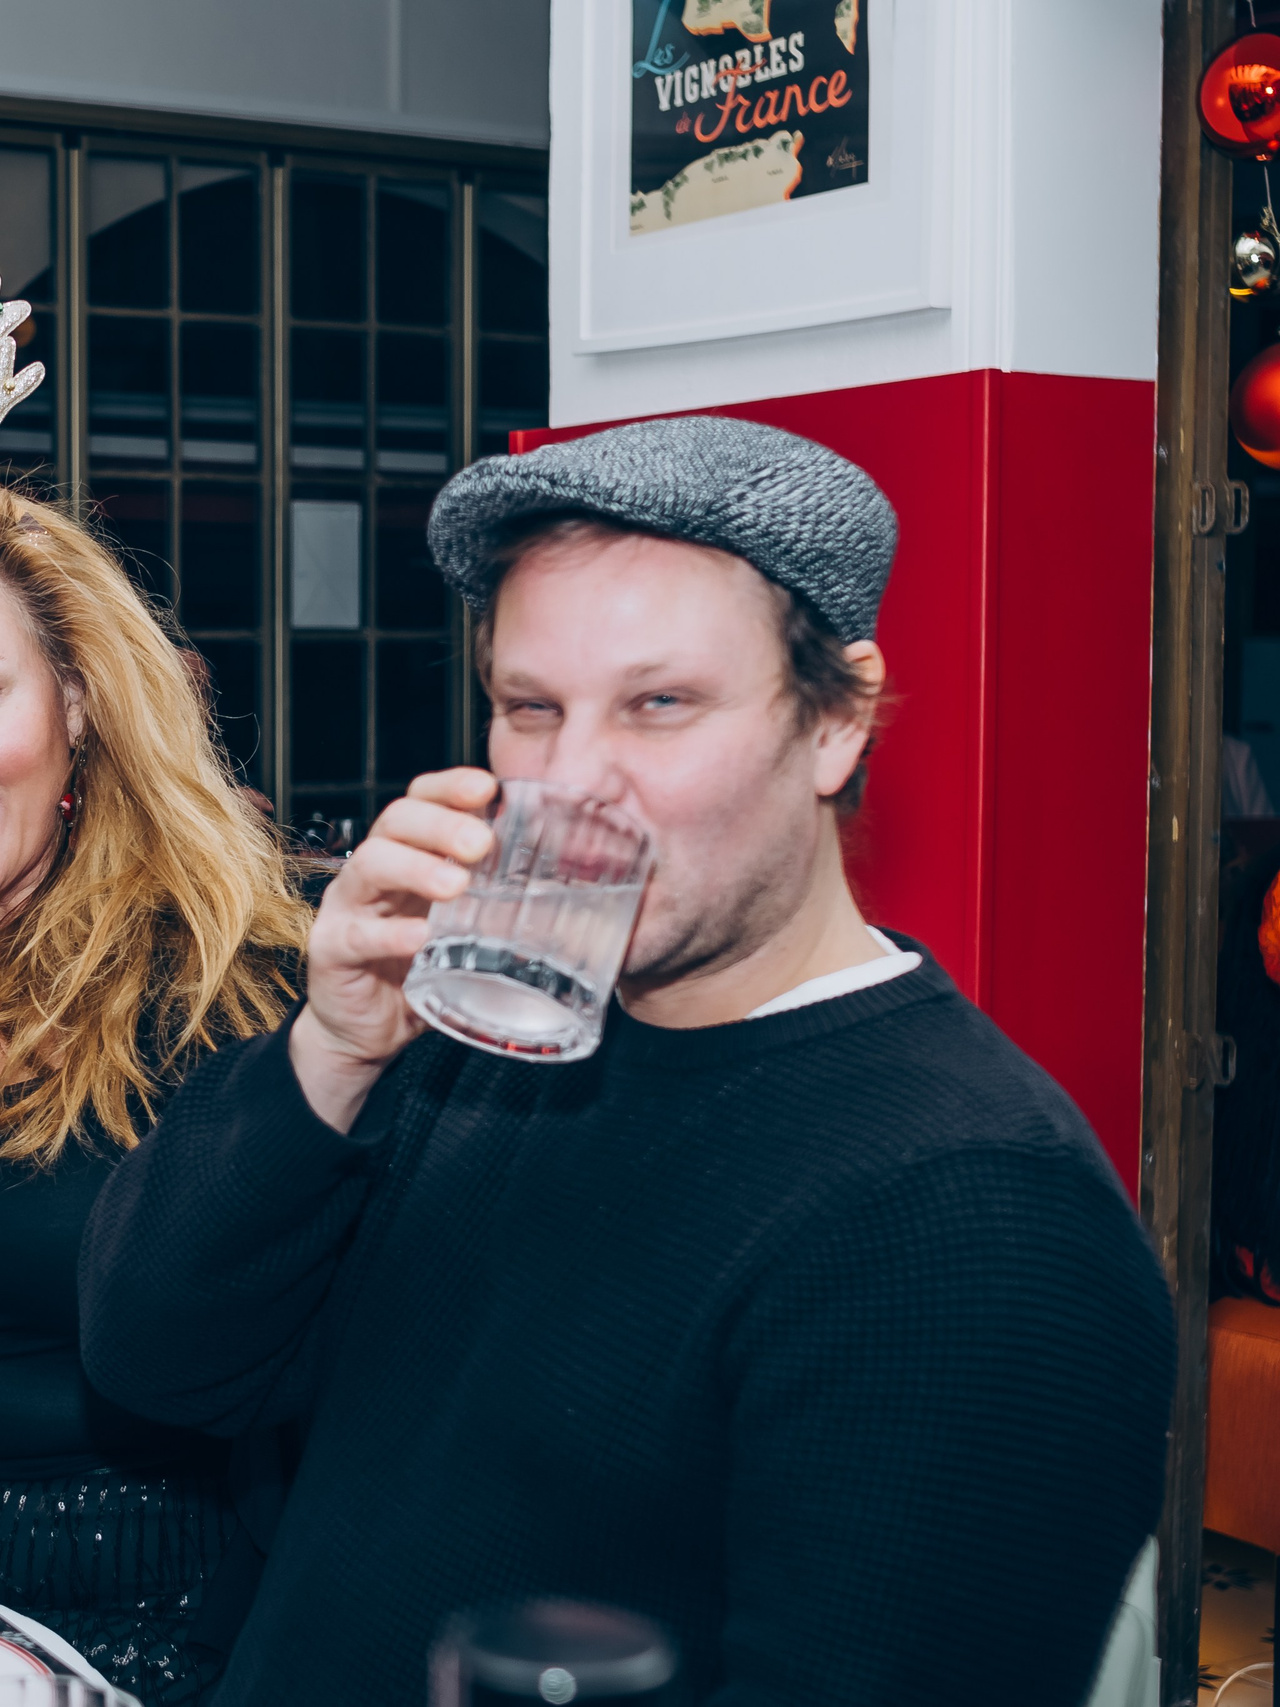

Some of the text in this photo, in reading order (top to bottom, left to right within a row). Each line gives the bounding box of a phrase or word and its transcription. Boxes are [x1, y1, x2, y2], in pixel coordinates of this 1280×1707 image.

[631, 0, 691, 79] Les
[654, 31, 805, 112] VIGNOBLES
[693, 57, 853, 143] France
